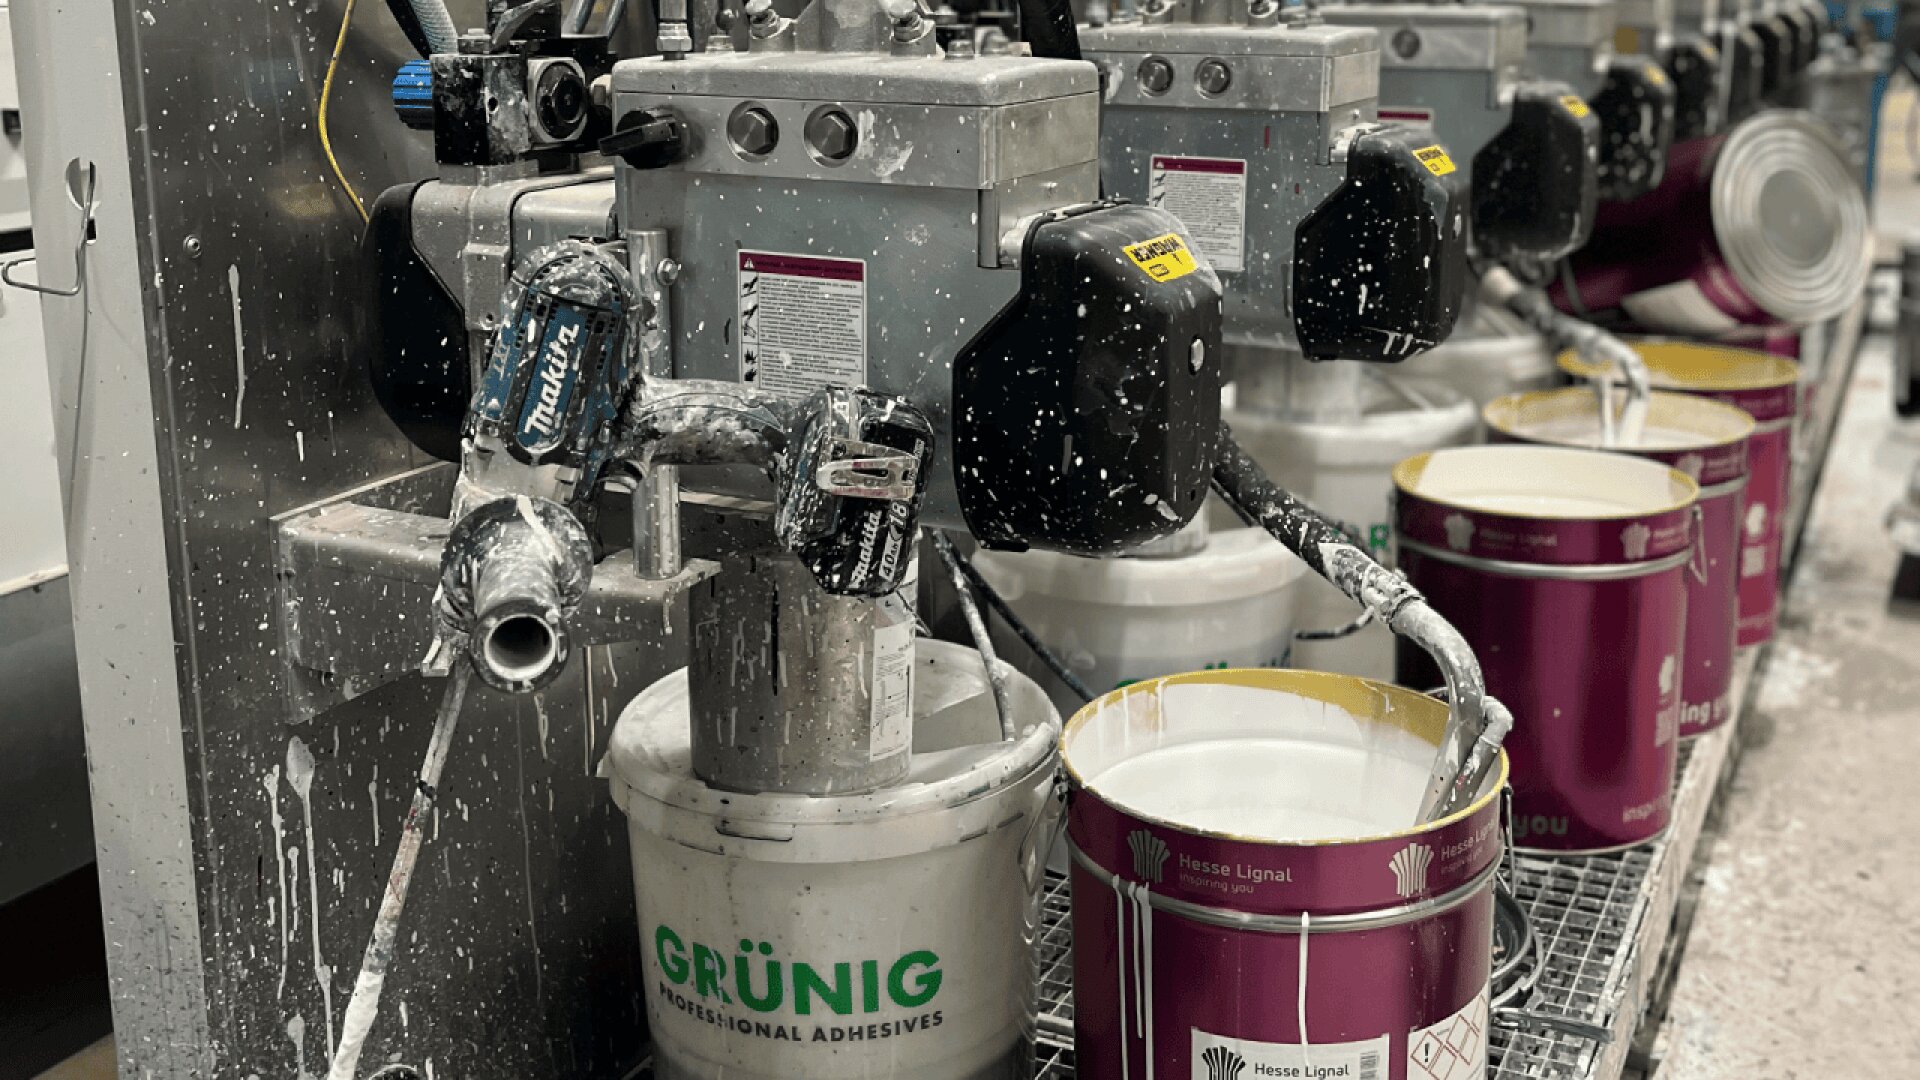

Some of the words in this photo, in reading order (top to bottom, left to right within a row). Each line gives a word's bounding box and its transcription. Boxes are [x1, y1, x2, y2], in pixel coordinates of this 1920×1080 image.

[524, 323, 580, 436] makita
[848, 509, 882, 588] makita
[1179, 853, 1230, 876] Hesse
[1236, 863, 1294, 883] Lignal
[1179, 873, 1228, 892] inspiring
[1231, 884, 1255, 894] you
[655, 924, 943, 1016] GRÜNIG
[812, 1010, 943, 1042] ADHESIVES
[1254, 1062, 1300, 1077] Hesse
[1304, 1063, 1350, 1080] Lignal
